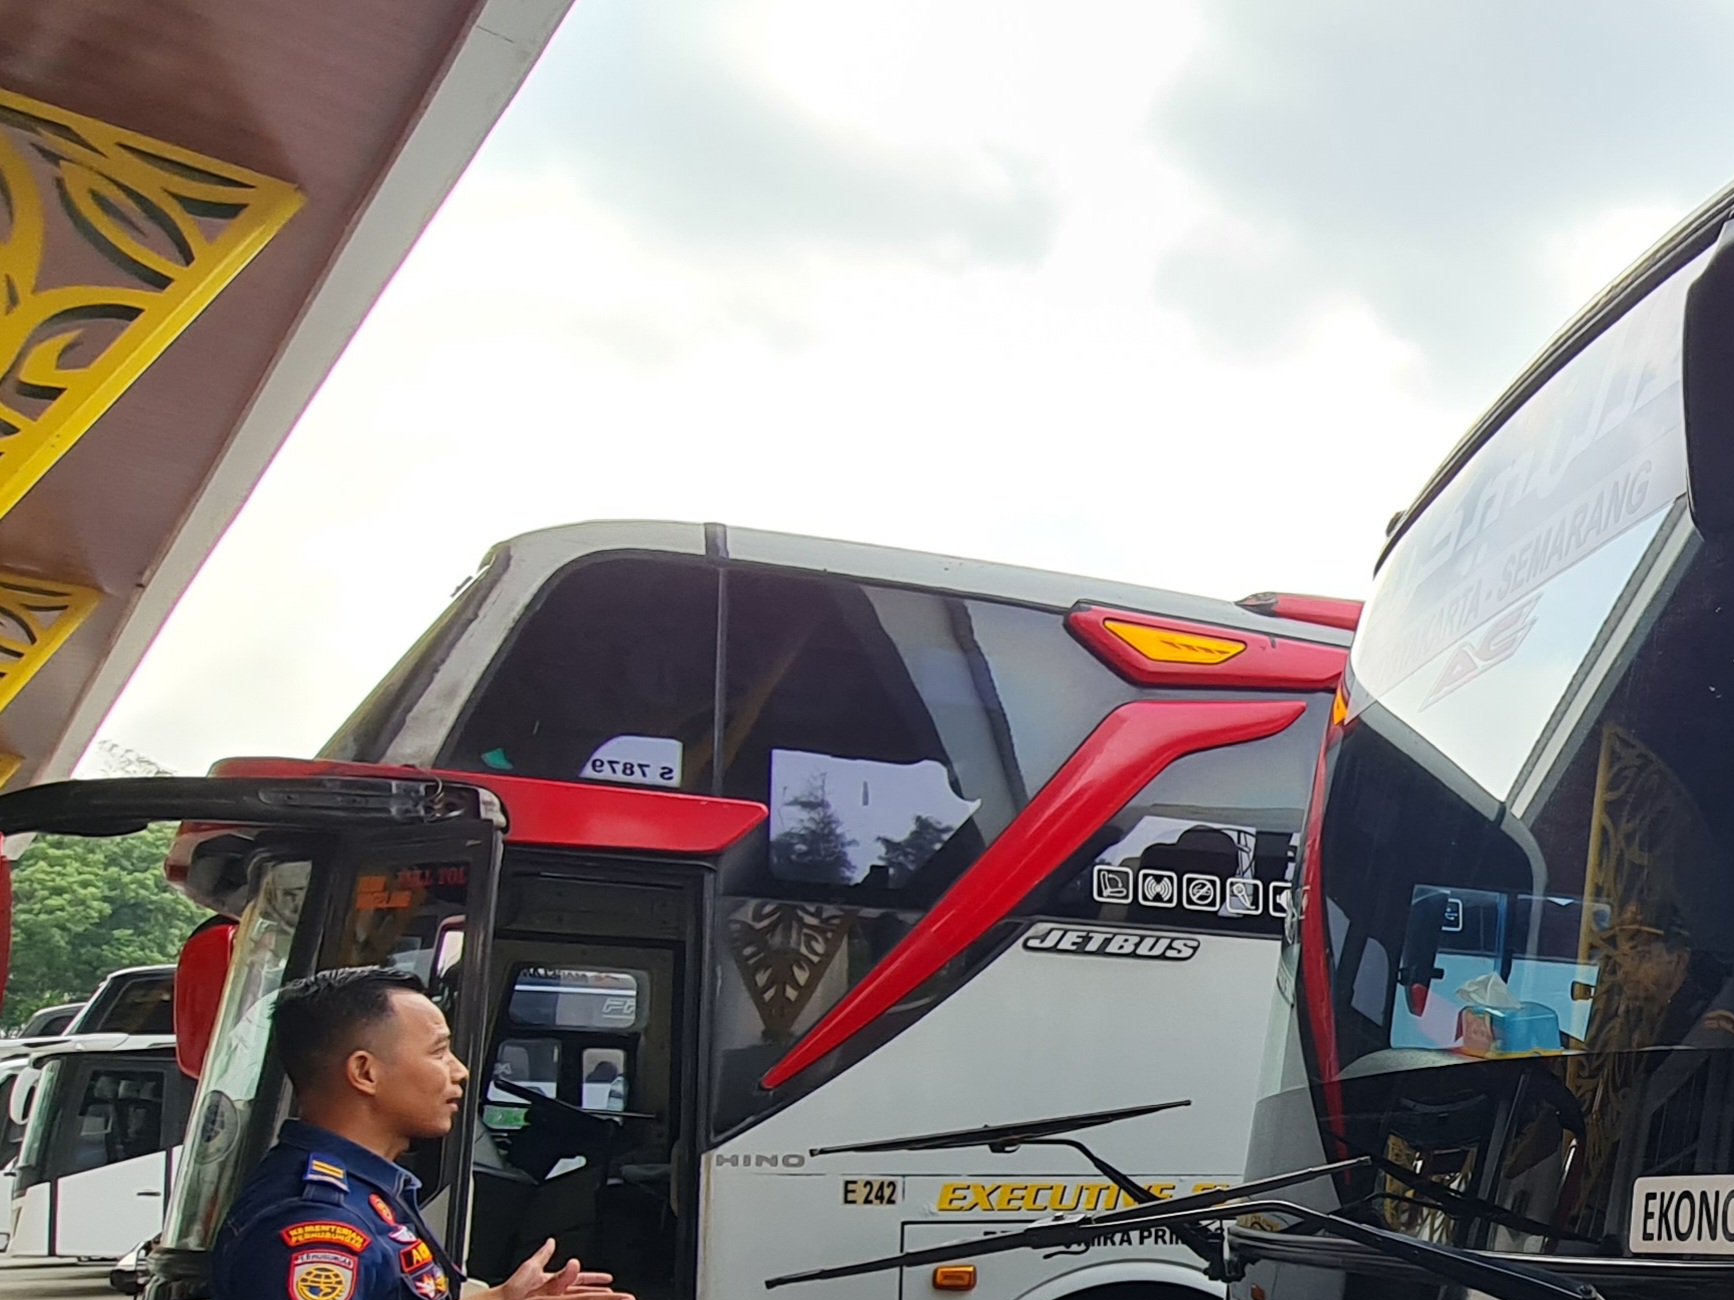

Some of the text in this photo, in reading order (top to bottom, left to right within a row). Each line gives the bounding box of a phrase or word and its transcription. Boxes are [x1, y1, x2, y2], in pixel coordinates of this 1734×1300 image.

[1499, 459, 1654, 598] SEMARANG
[1026, 929, 1200, 959] JETBUS
[716, 1154, 805, 1168] HINO
[843, 1180, 896, 1204] E 242
[936, 1182, 1175, 1211] EXECUTIE
